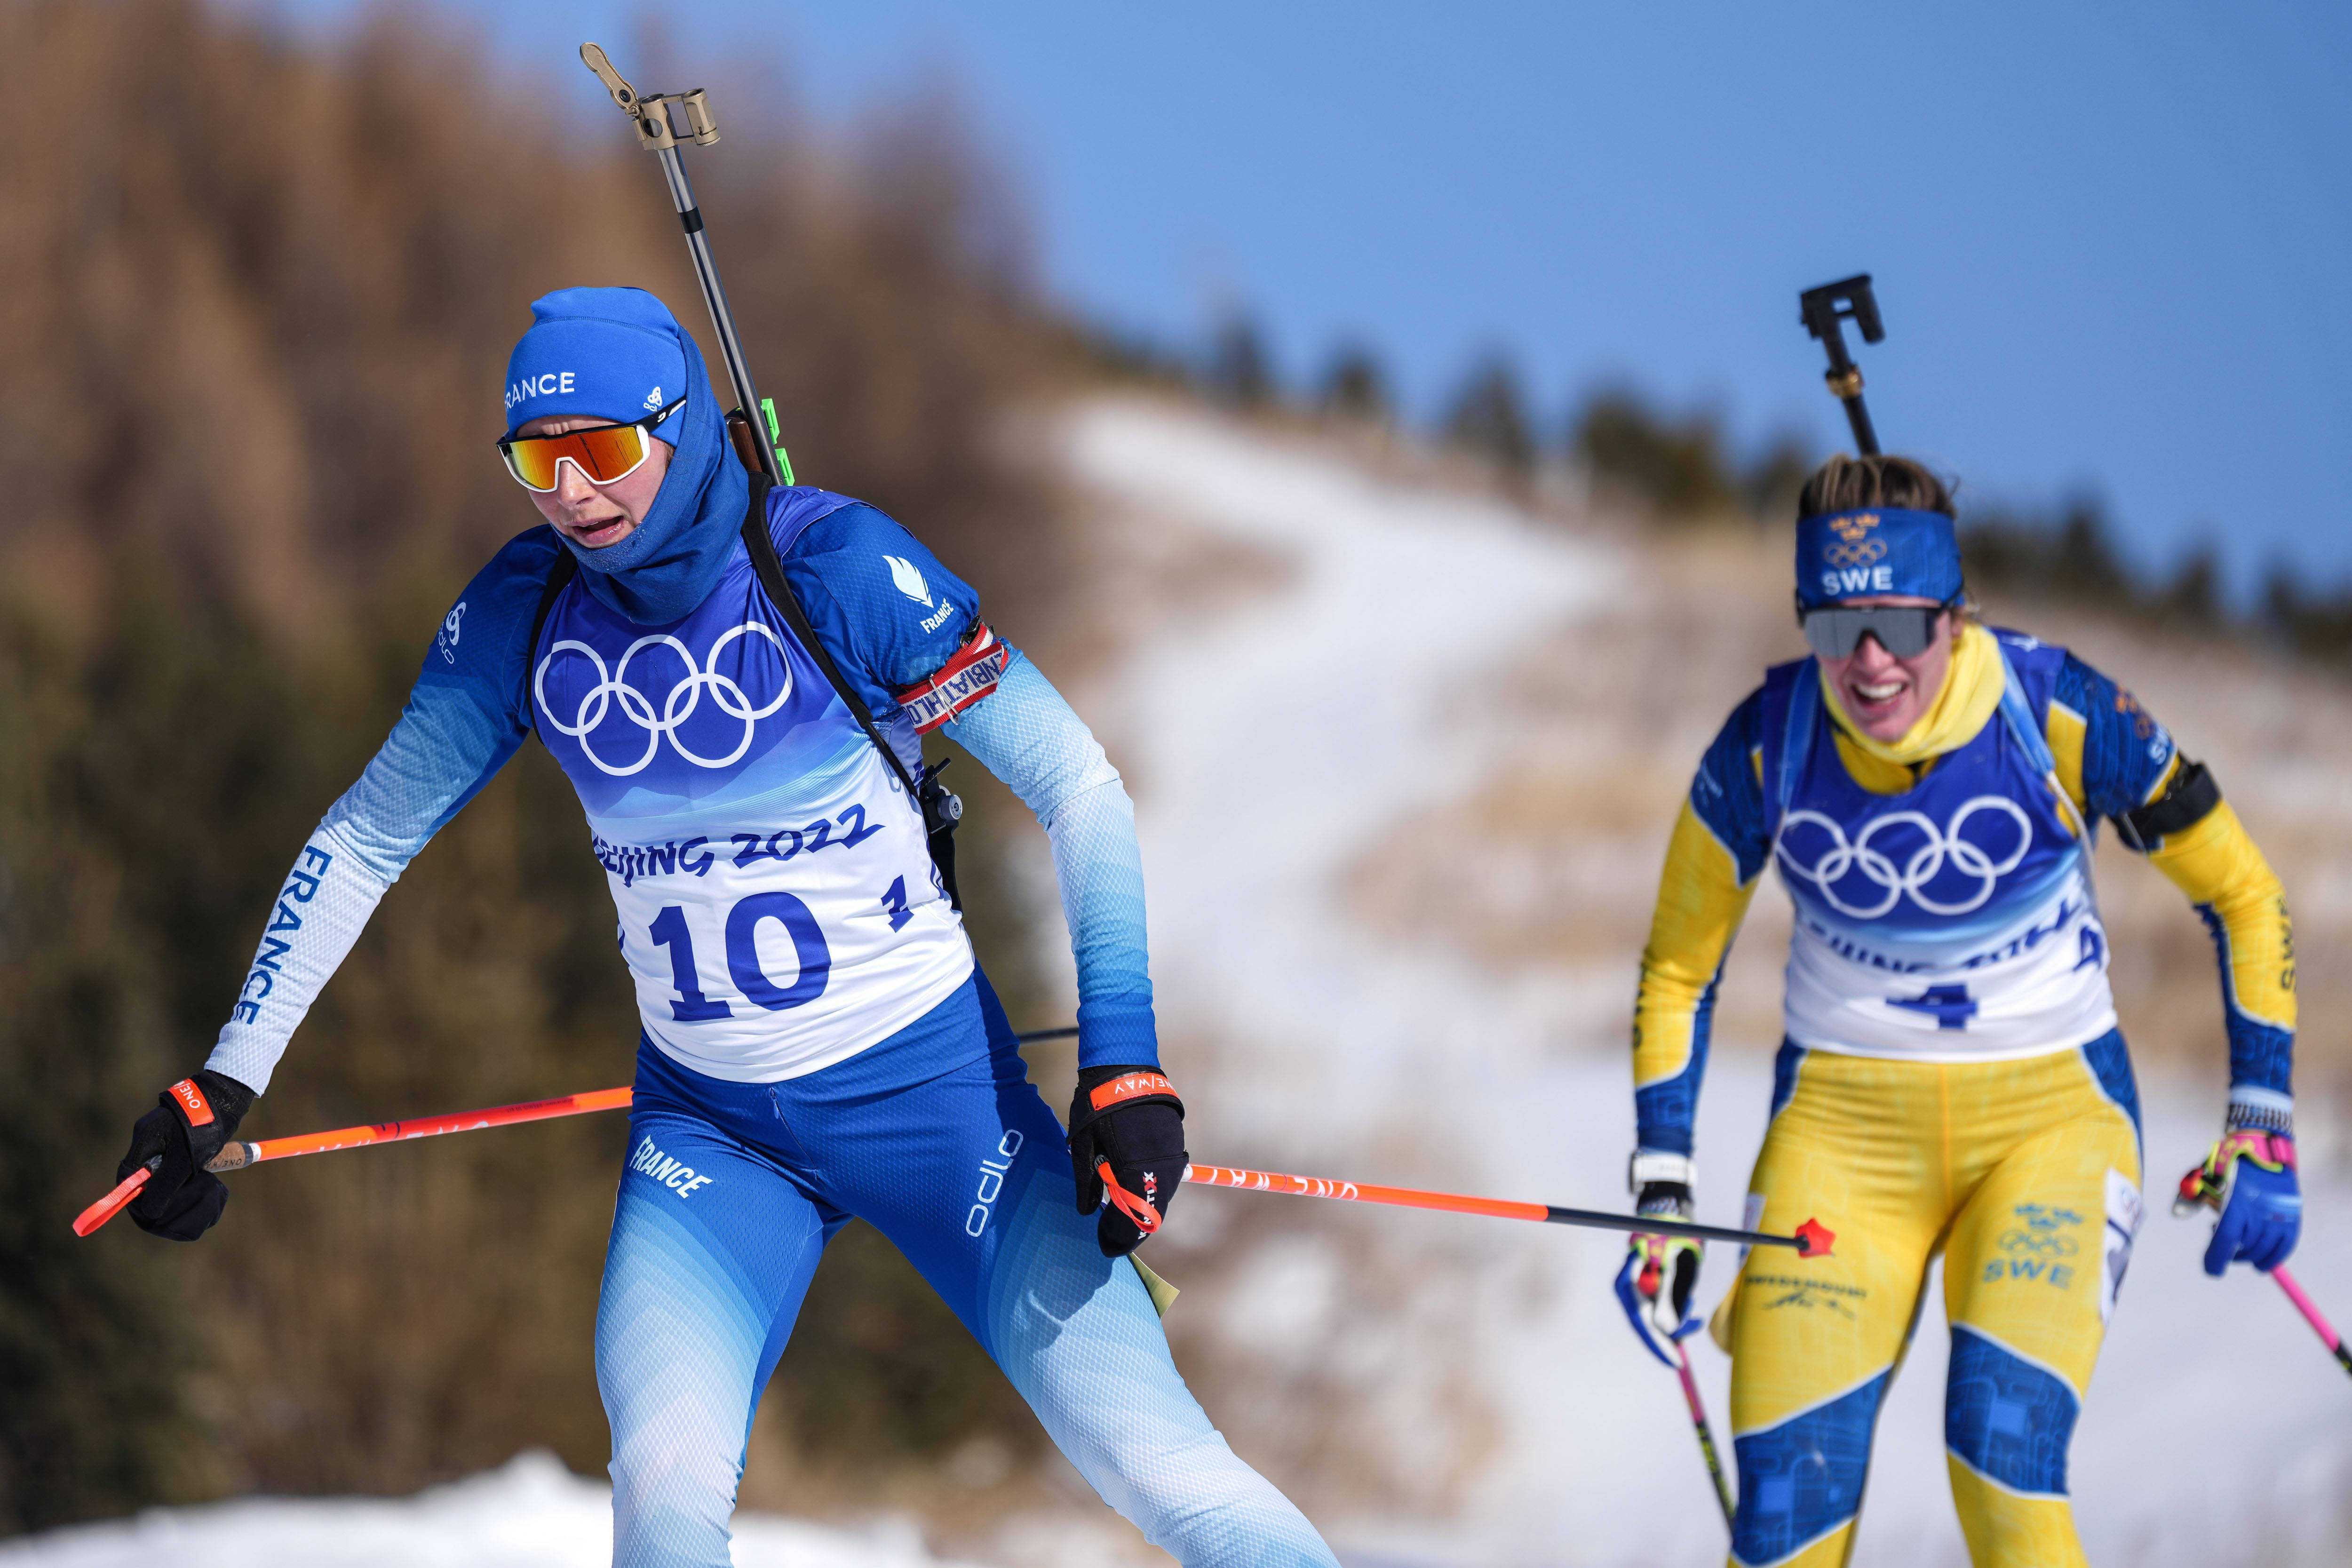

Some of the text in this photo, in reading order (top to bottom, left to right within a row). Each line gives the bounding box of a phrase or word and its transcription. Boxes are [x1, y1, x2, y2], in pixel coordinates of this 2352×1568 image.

[1821, 565, 1894, 596] SWE
[920, 597, 954, 634] FRANCE
[730, 803, 885, 869] 2022
[233, 845, 333, 1025] FRANCE
[648, 892, 832, 1021] 10
[629, 1134, 713, 1199] FRANCE
[966, 1129, 1024, 1237] odlo
[1137, 1171, 1158, 1240] KNTIXX
[1983, 1259, 2075, 1290] SWE
